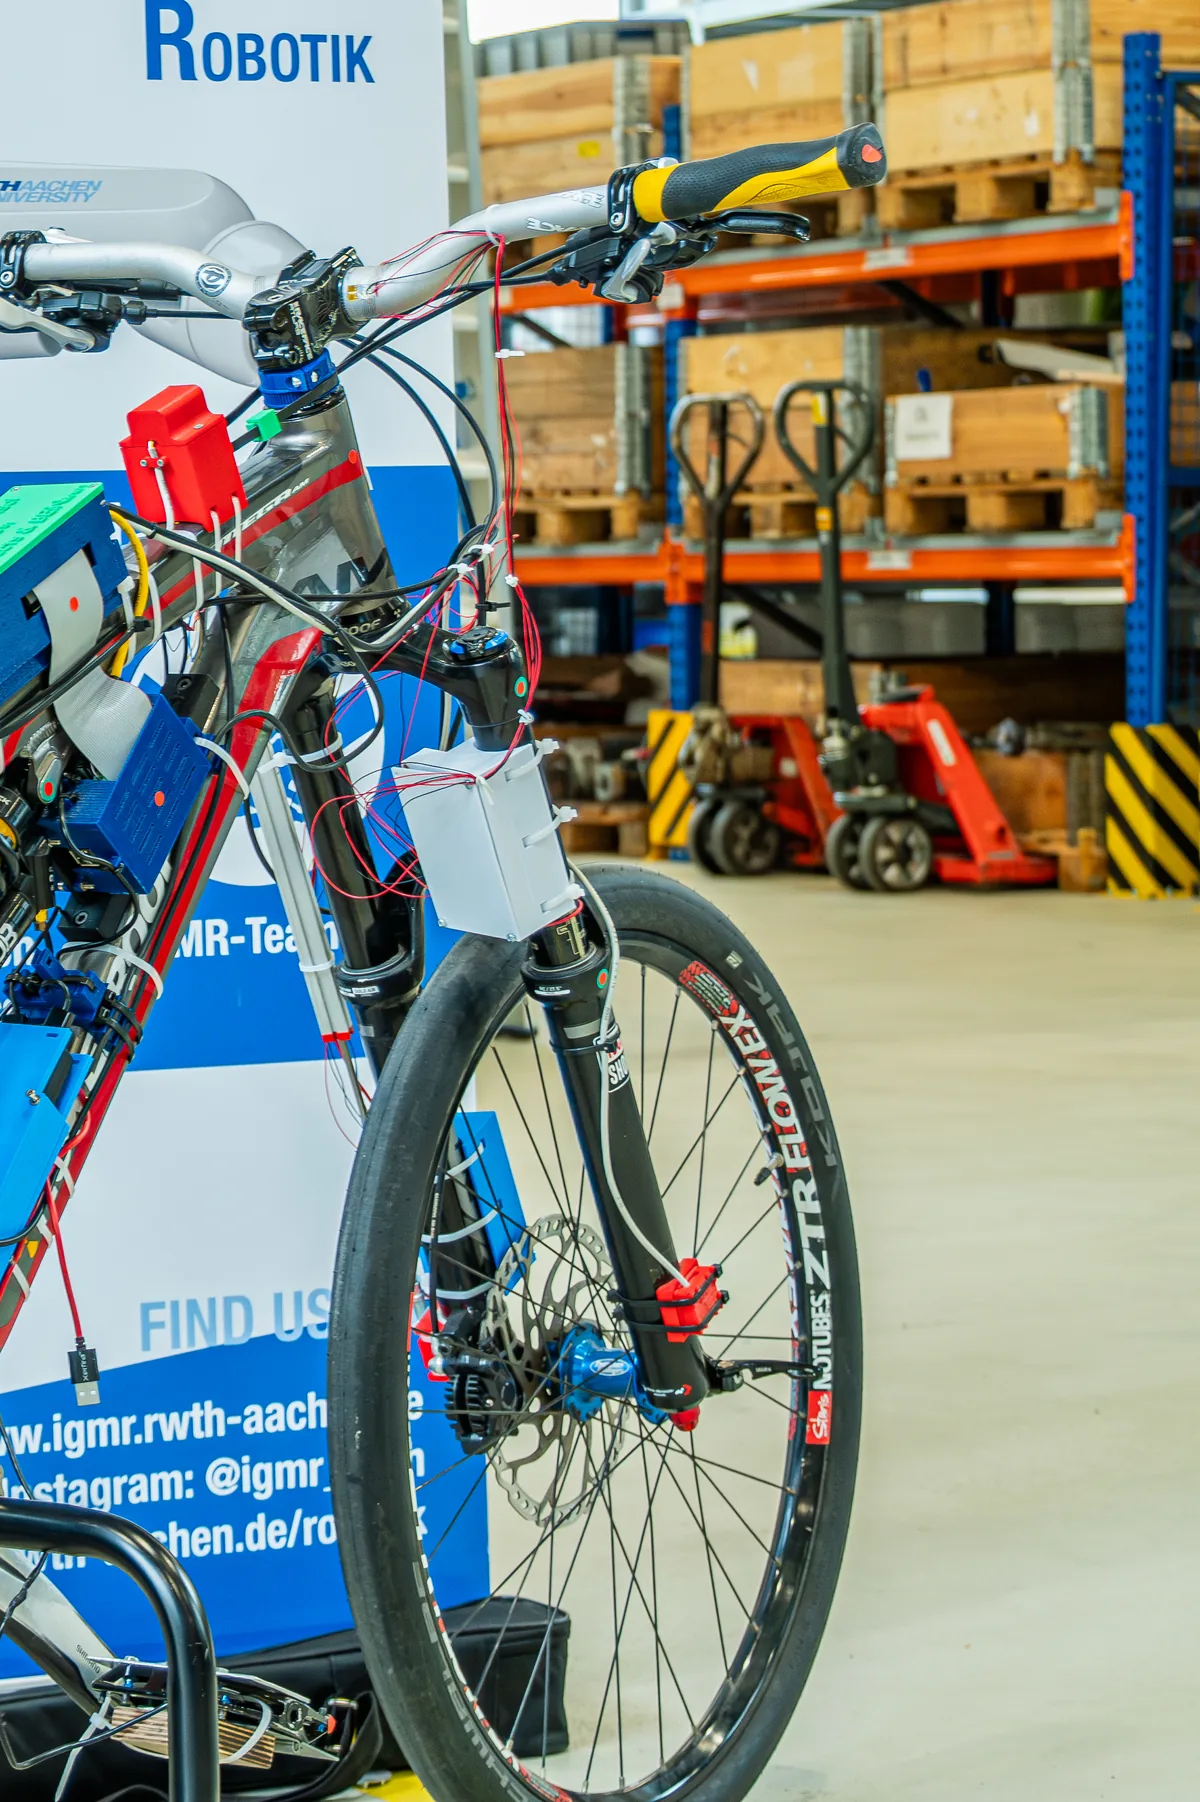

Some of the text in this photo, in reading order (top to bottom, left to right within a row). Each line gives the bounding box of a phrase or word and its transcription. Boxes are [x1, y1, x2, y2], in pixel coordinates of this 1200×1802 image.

[145, 0, 376, 83] ROBOTIK
[608, 1053, 629, 1085] SHO
[717, 1004, 768, 1055] EX
[742, 971, 837, 1166] KOJAK
[746, 1057, 811, 1170] FLOW
[792, 1177, 832, 1291] ZTR
[140, 1286, 330, 1352] FIND US
